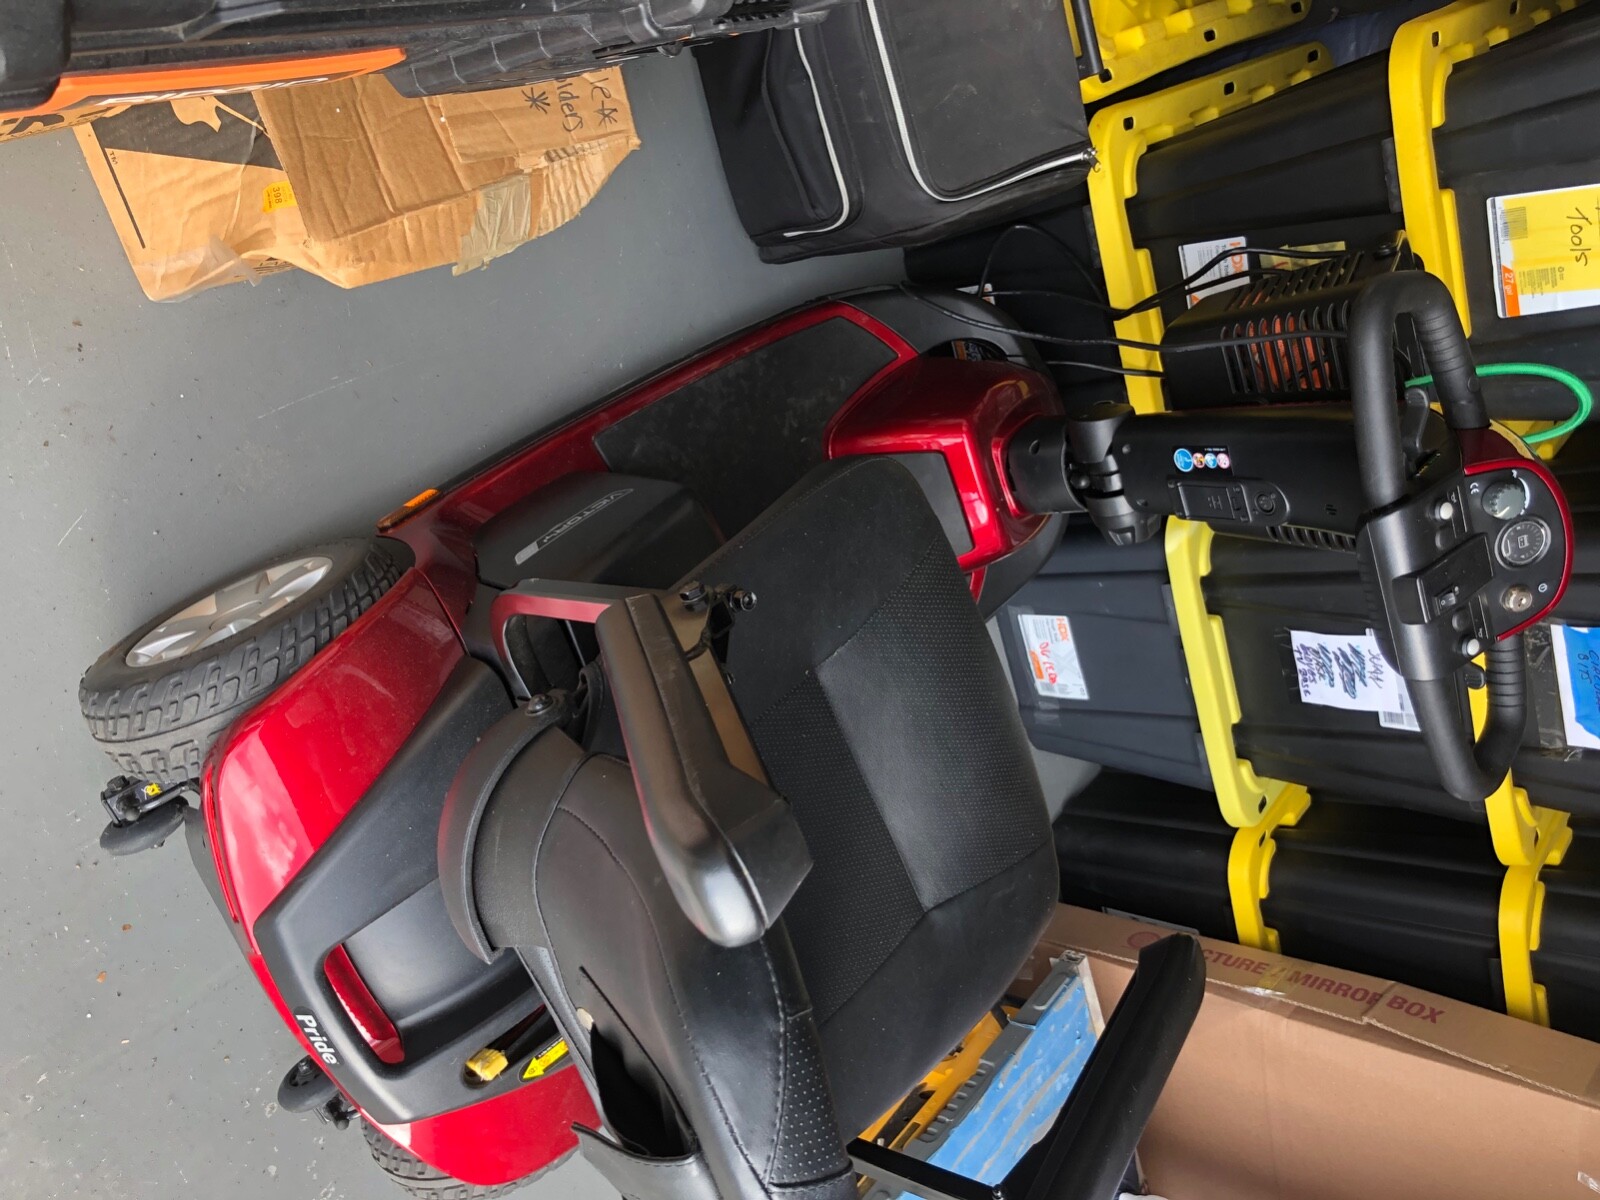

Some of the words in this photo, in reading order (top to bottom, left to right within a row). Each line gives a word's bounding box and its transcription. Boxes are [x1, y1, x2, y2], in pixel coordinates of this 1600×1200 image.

[272, 186, 283, 204] 398
[1566, 207, 1593, 266] Tools
[1504, 272, 1514, 284] 27
[543, 493, 622, 542] VICTORY
[1204, 948, 1270, 975] CTURE
[1386, 994, 1446, 1024] BOX
[295, 1015, 337, 1064] Pride
